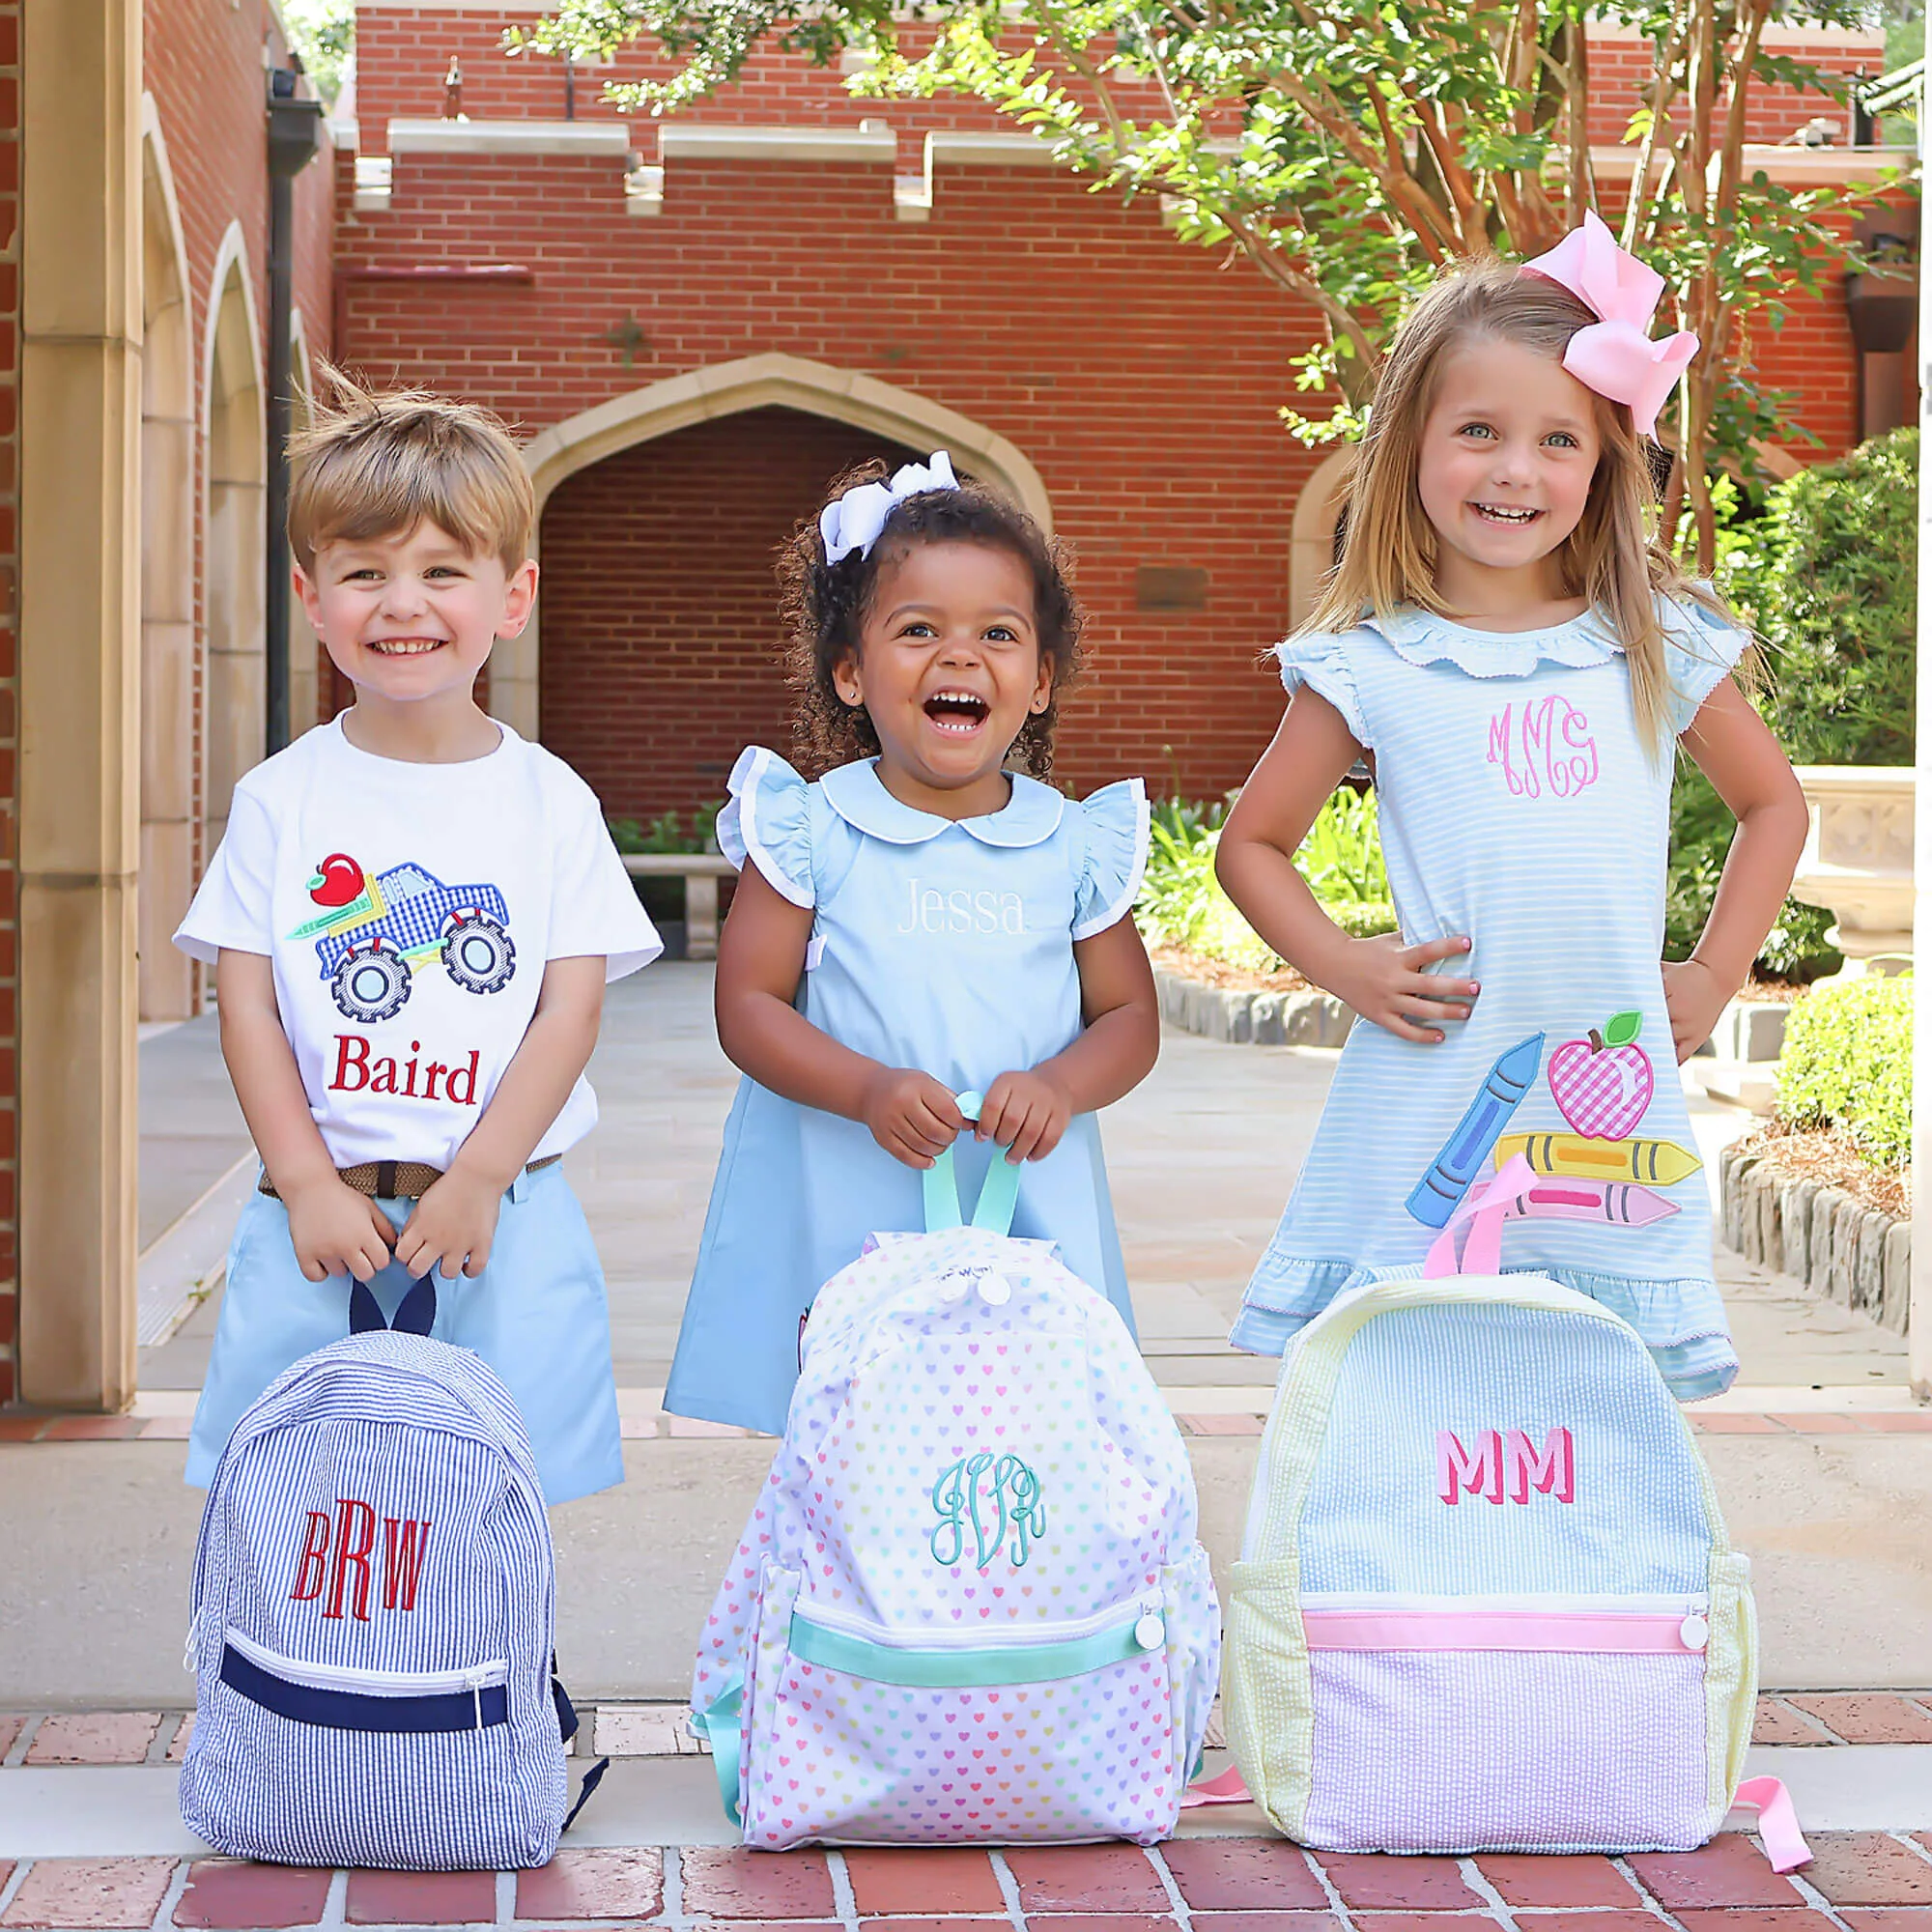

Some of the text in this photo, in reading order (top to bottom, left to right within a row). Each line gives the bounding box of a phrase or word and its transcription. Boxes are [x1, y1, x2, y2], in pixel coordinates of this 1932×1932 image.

[897, 878, 1027, 934] Jessa
[328, 1036, 479, 1105] Baird
[1435, 1426, 1574, 1505] MM
[289, 1499, 432, 1622] BRW
